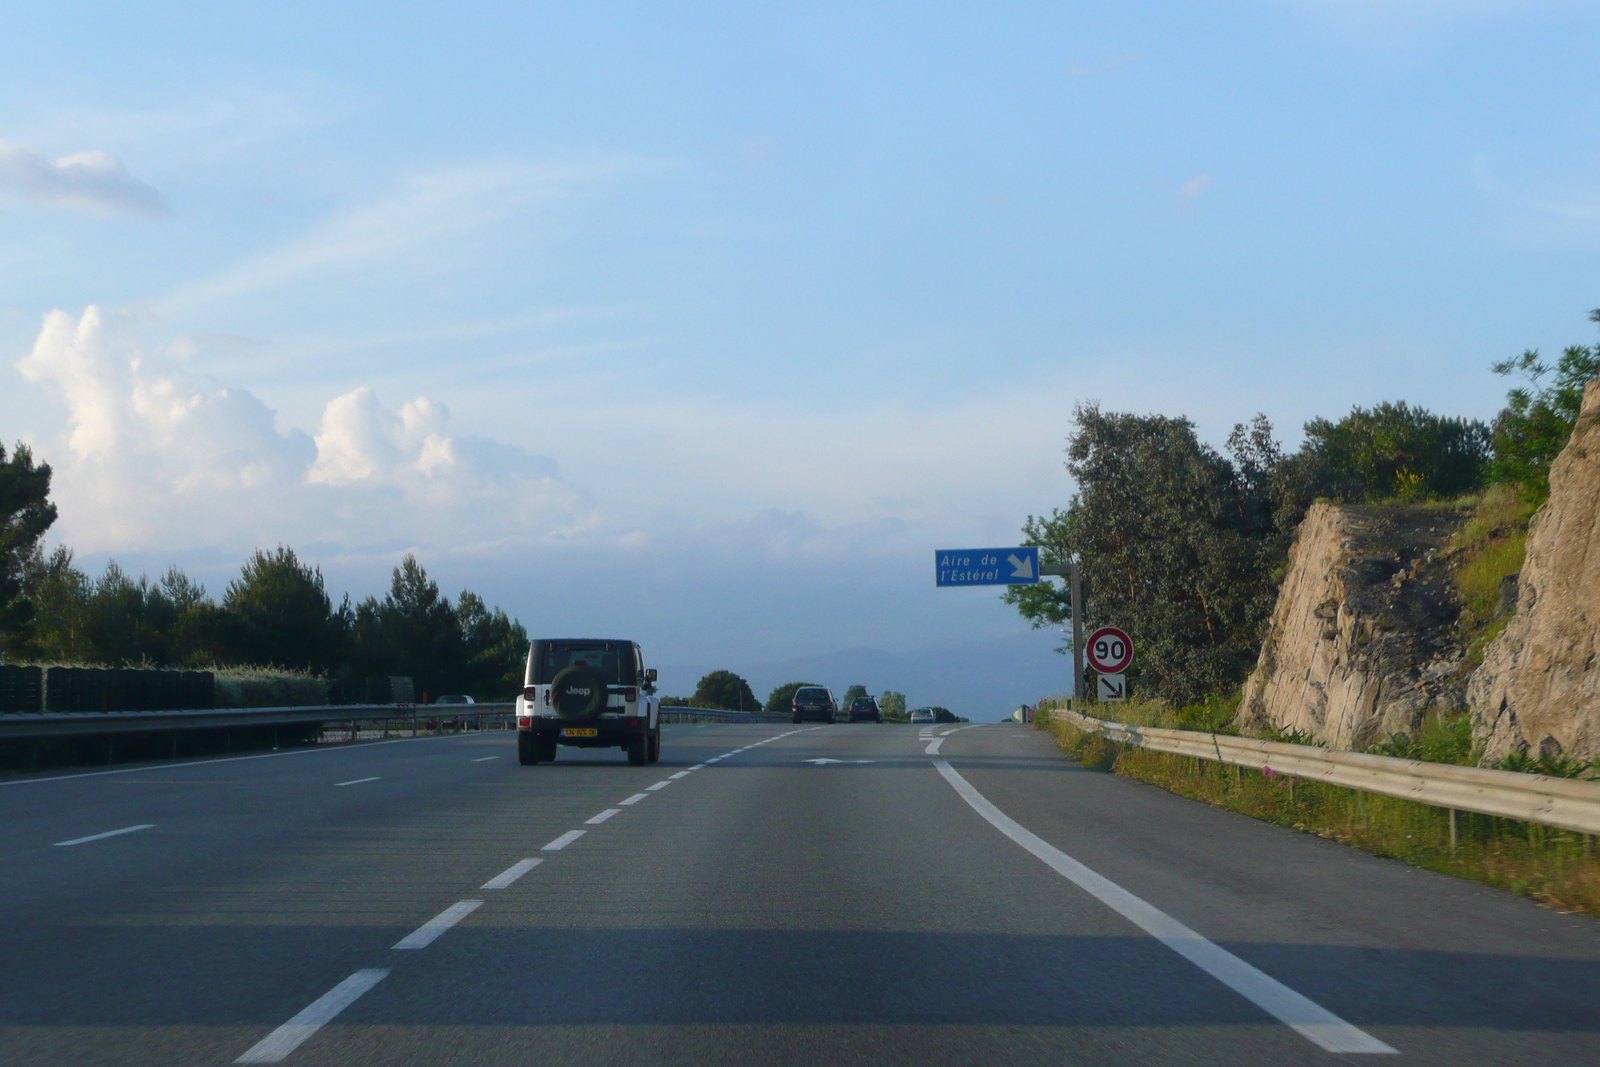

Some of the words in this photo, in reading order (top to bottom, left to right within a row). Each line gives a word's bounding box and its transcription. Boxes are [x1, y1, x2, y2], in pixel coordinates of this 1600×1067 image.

[941, 555, 970, 567] Aire
[981, 553, 997, 566] de
[941, 568, 998, 582] l'Estérel
[1095, 640, 1125, 660] 90
[566, 685, 590, 697] Jeep
